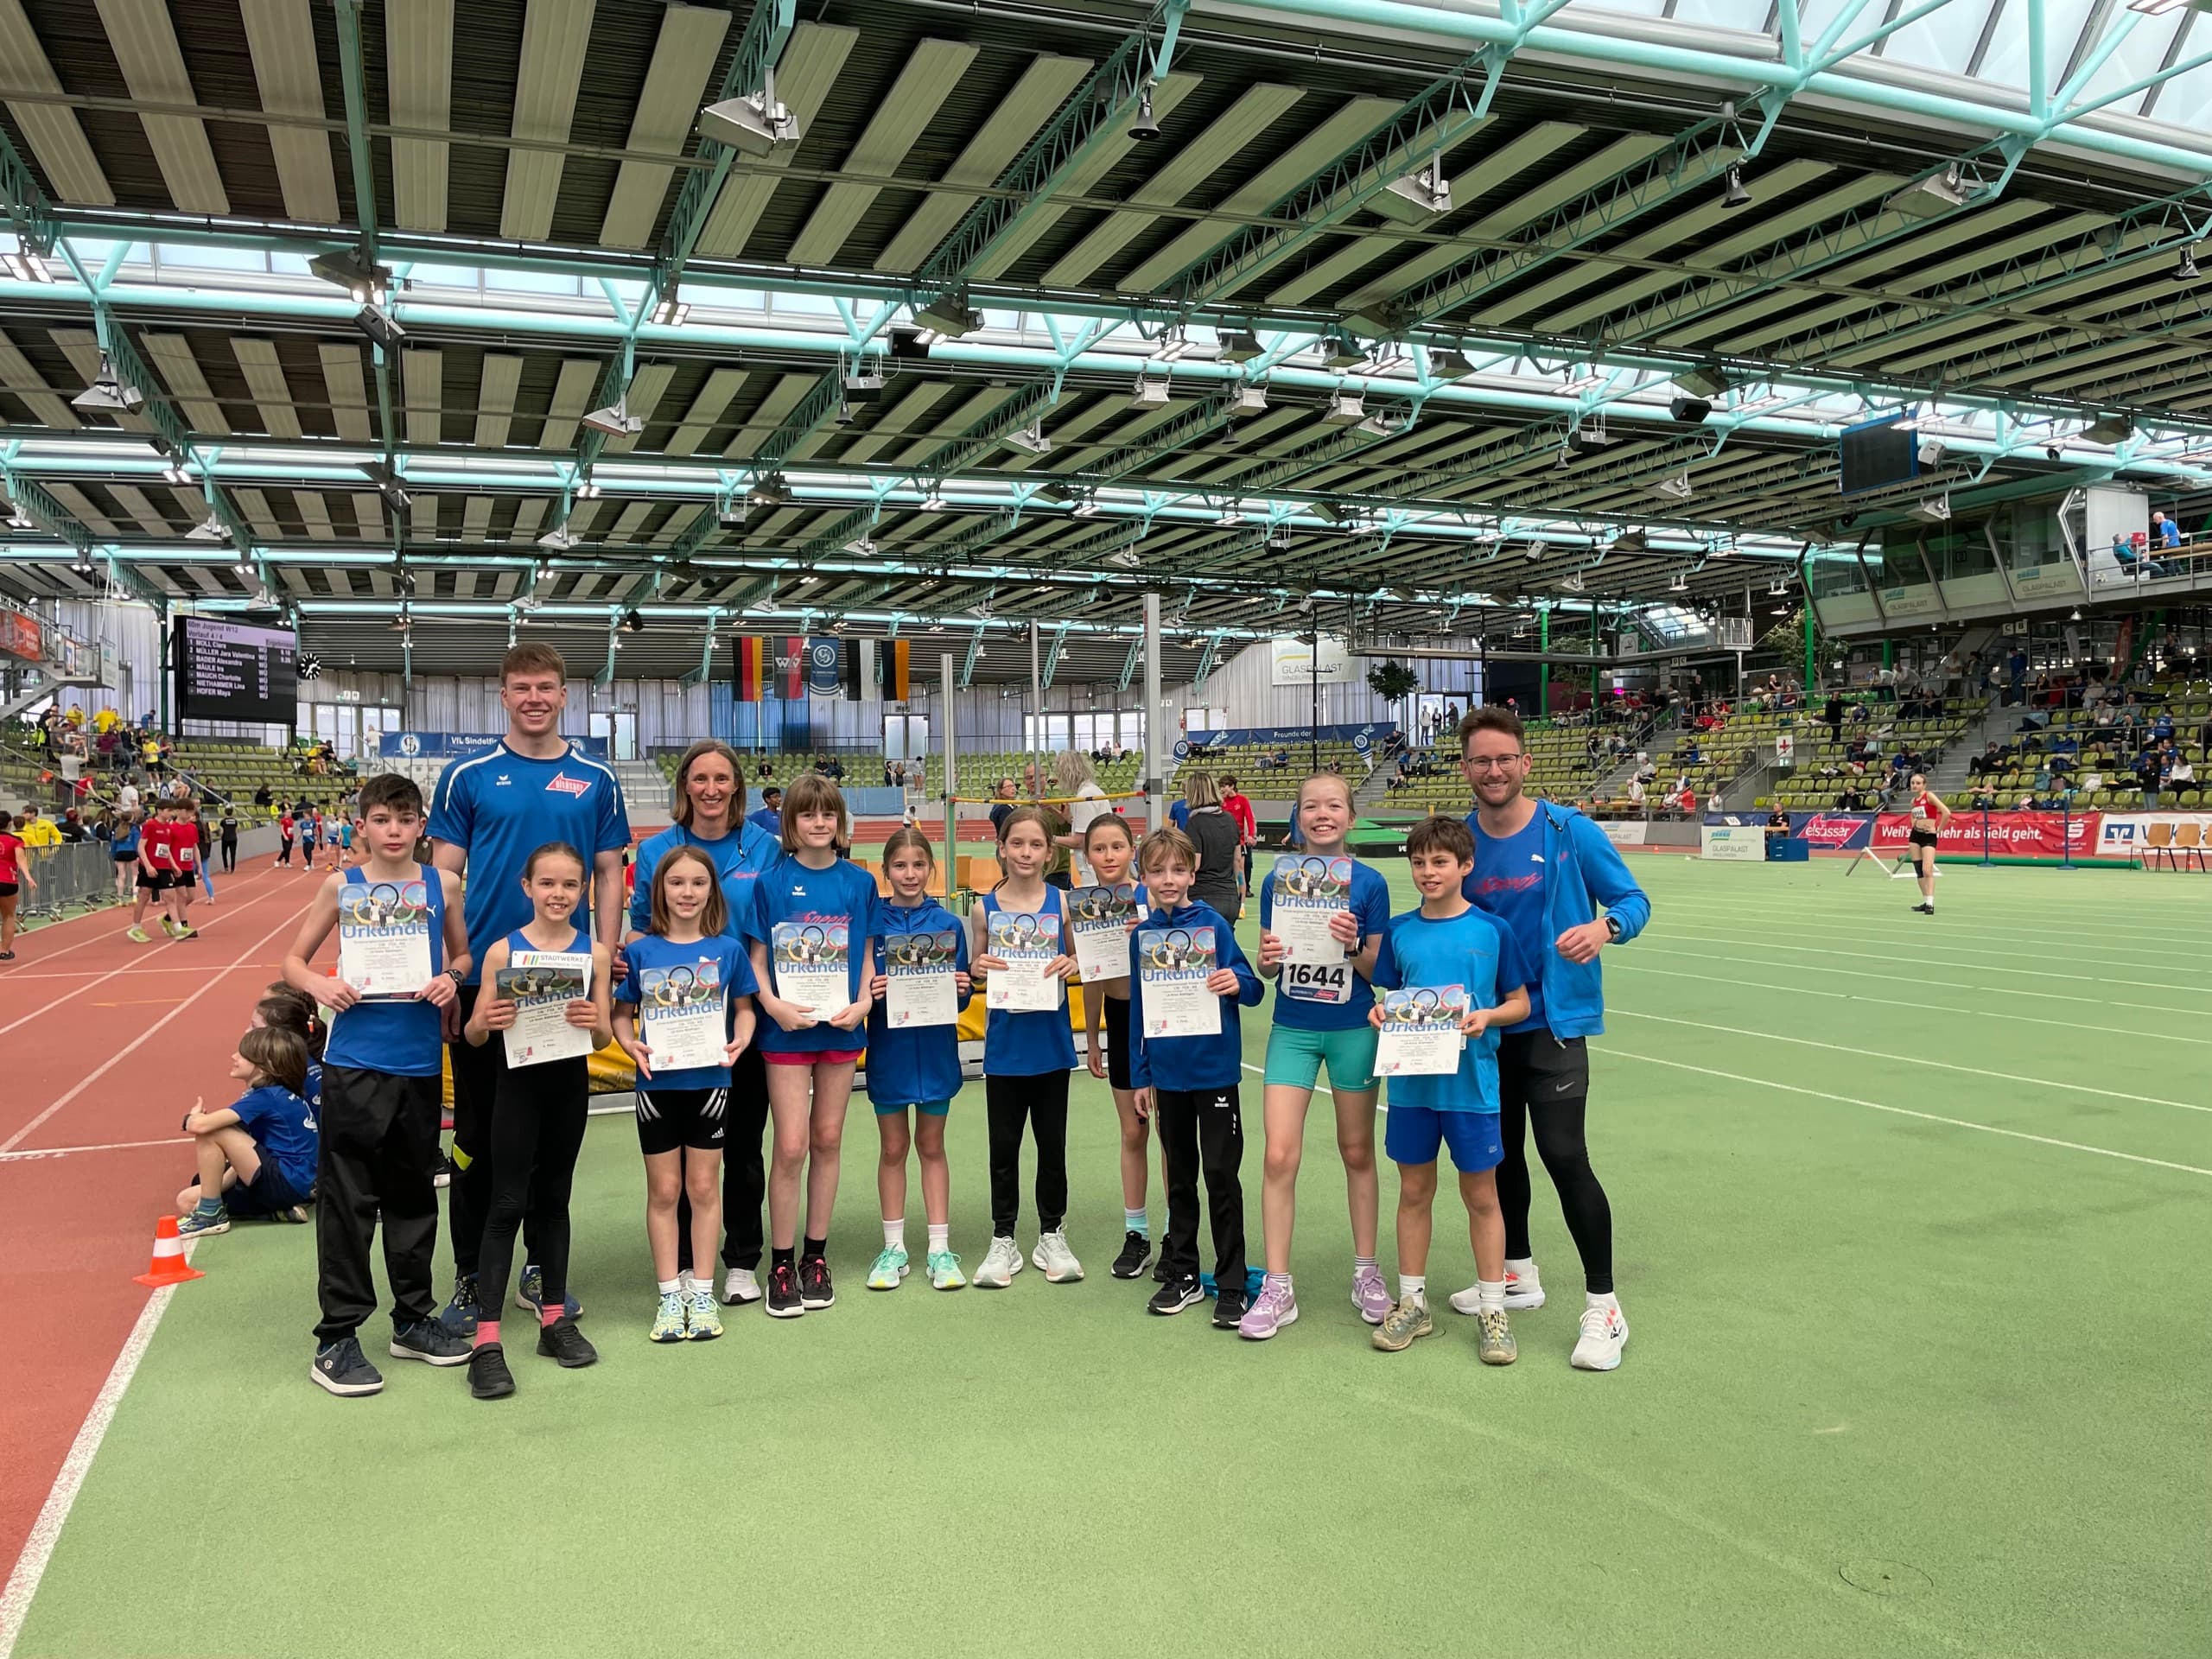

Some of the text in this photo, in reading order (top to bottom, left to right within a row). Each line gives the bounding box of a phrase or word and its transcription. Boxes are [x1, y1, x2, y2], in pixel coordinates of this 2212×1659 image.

[1881, 825, 1912, 838] Weil's
[1963, 827, 1980, 839] als
[2012, 827, 2044, 842] geht.
[1273, 893, 1350, 910] Urkunde
[342, 921, 429, 938] Urkunde
[1073, 912, 1135, 933] Urkund
[540, 954, 583, 963] STADTWERKE
[988, 945, 1058, 959] Urkunde
[778, 959, 849, 974] Urkunde
[887, 961, 956, 977] Urkunde
[1288, 963, 1345, 988] 1644
[516, 988, 585, 1009] rkunde
[645, 1000, 722, 1021] Urkunde
